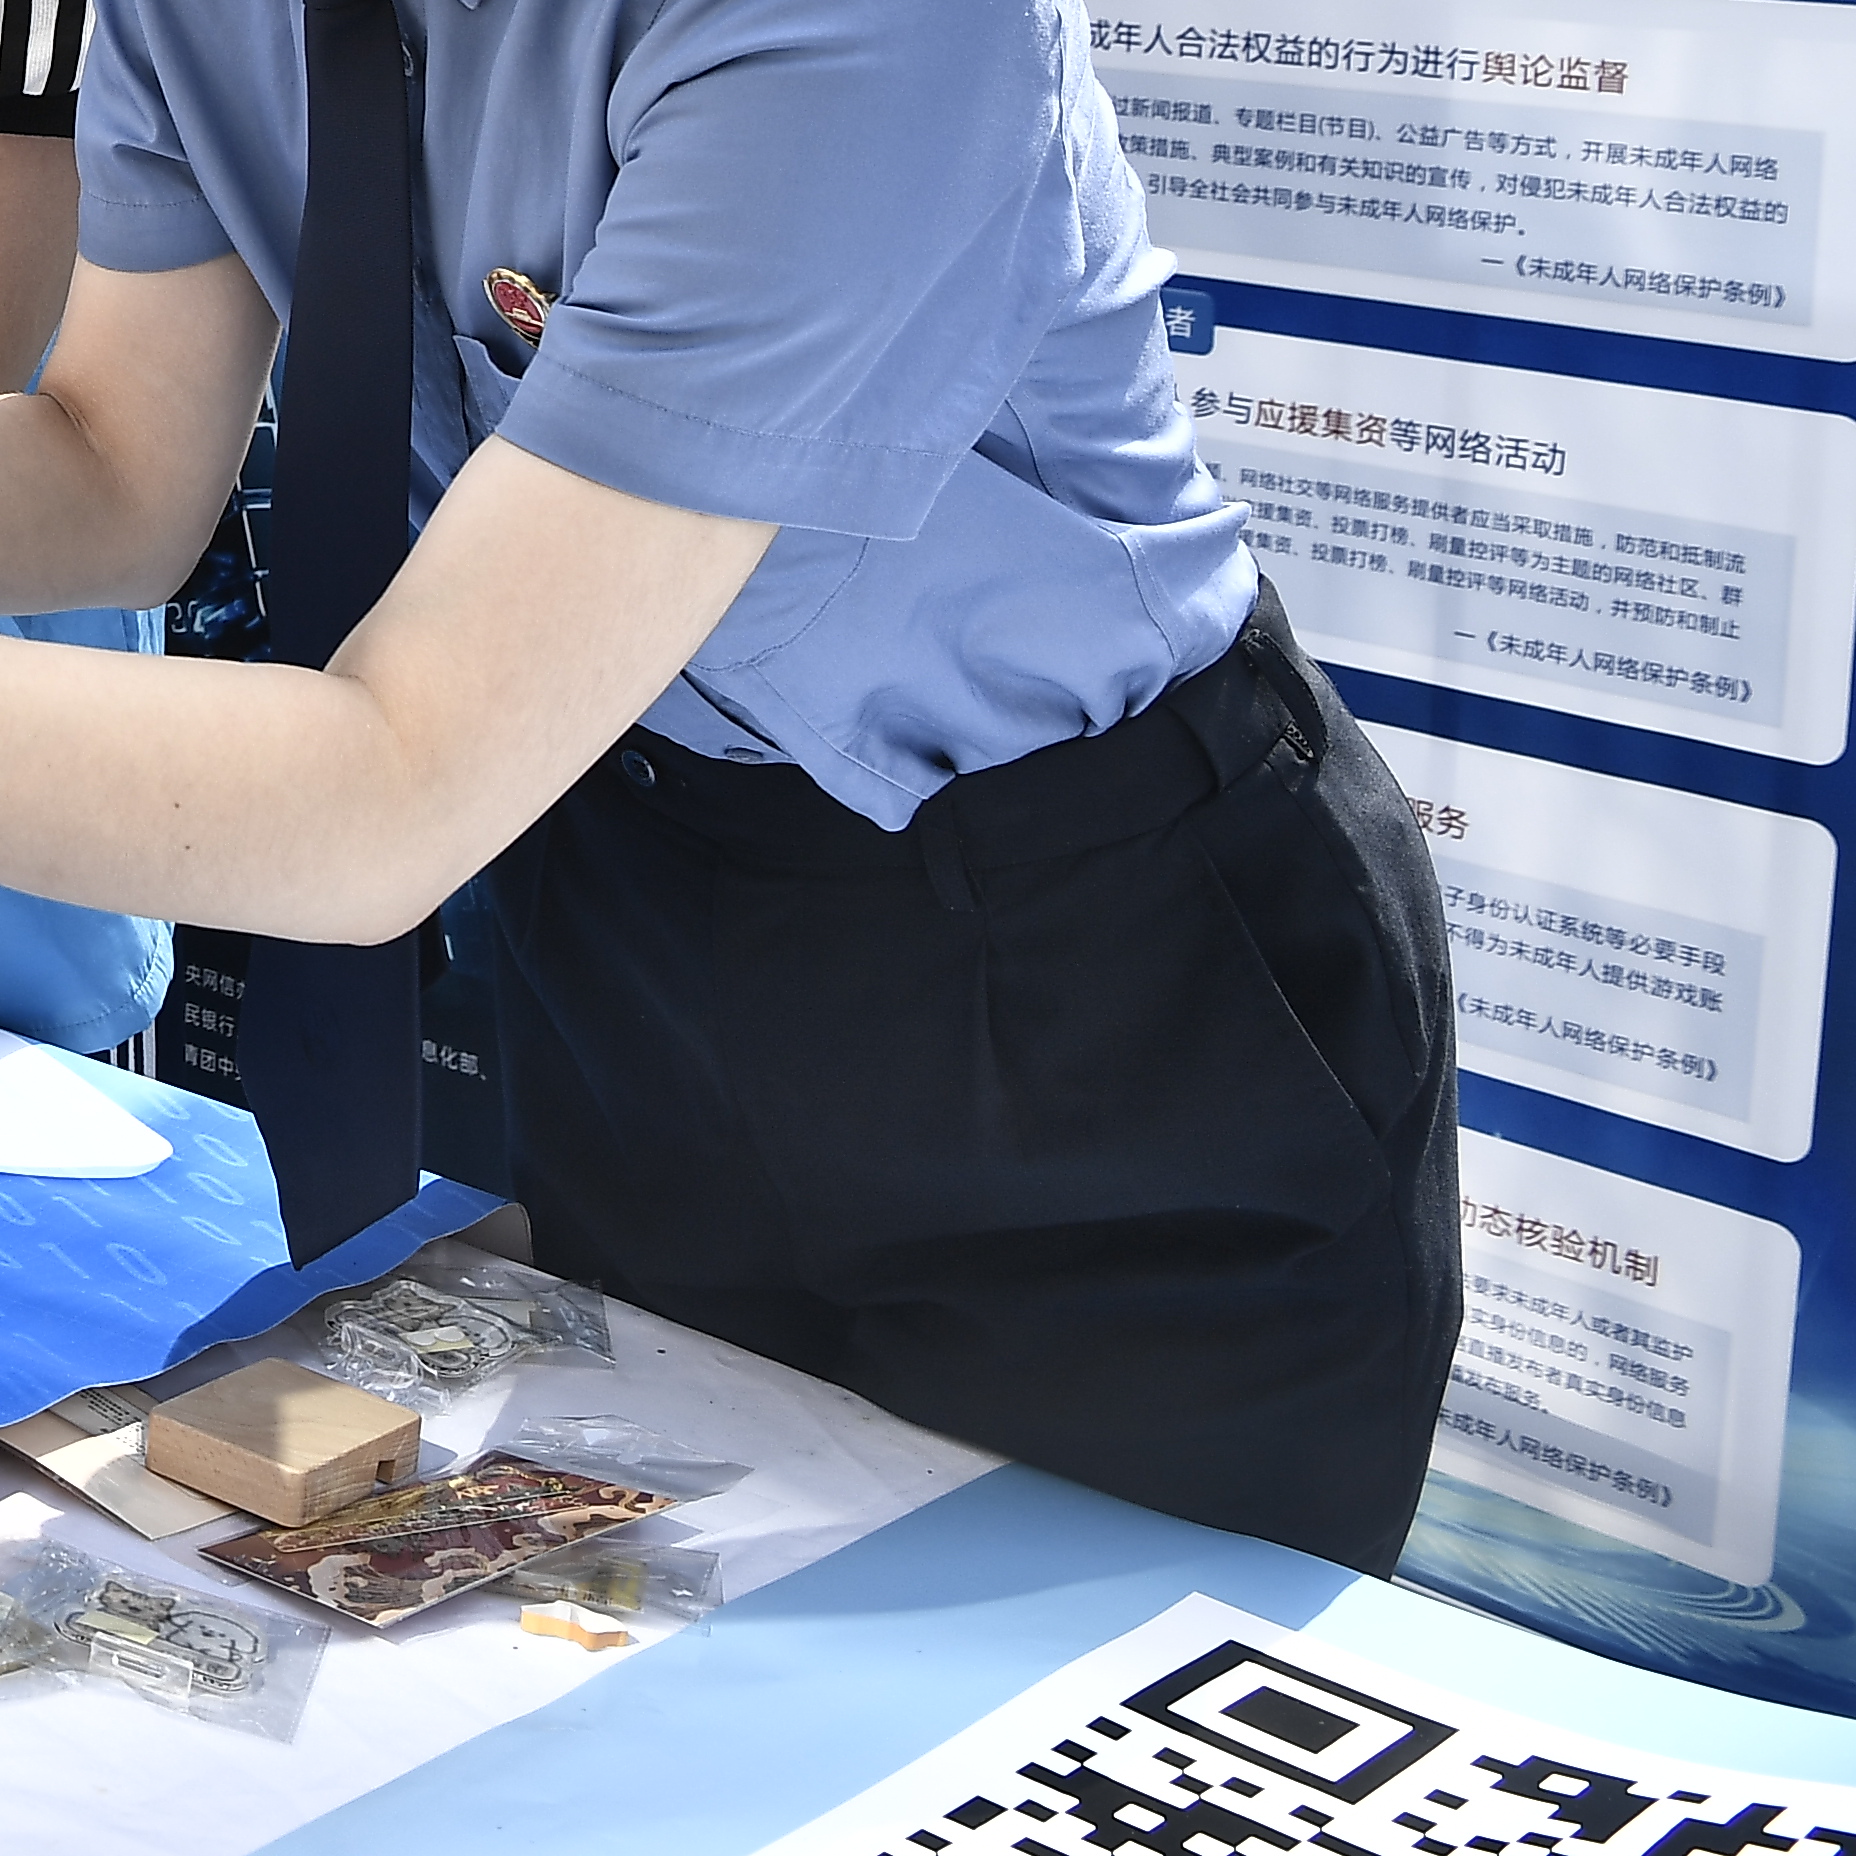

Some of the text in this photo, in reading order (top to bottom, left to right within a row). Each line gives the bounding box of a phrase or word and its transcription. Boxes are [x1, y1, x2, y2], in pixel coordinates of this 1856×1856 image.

[1190, 387, 1568, 477] 参与应援集资等网络活动
